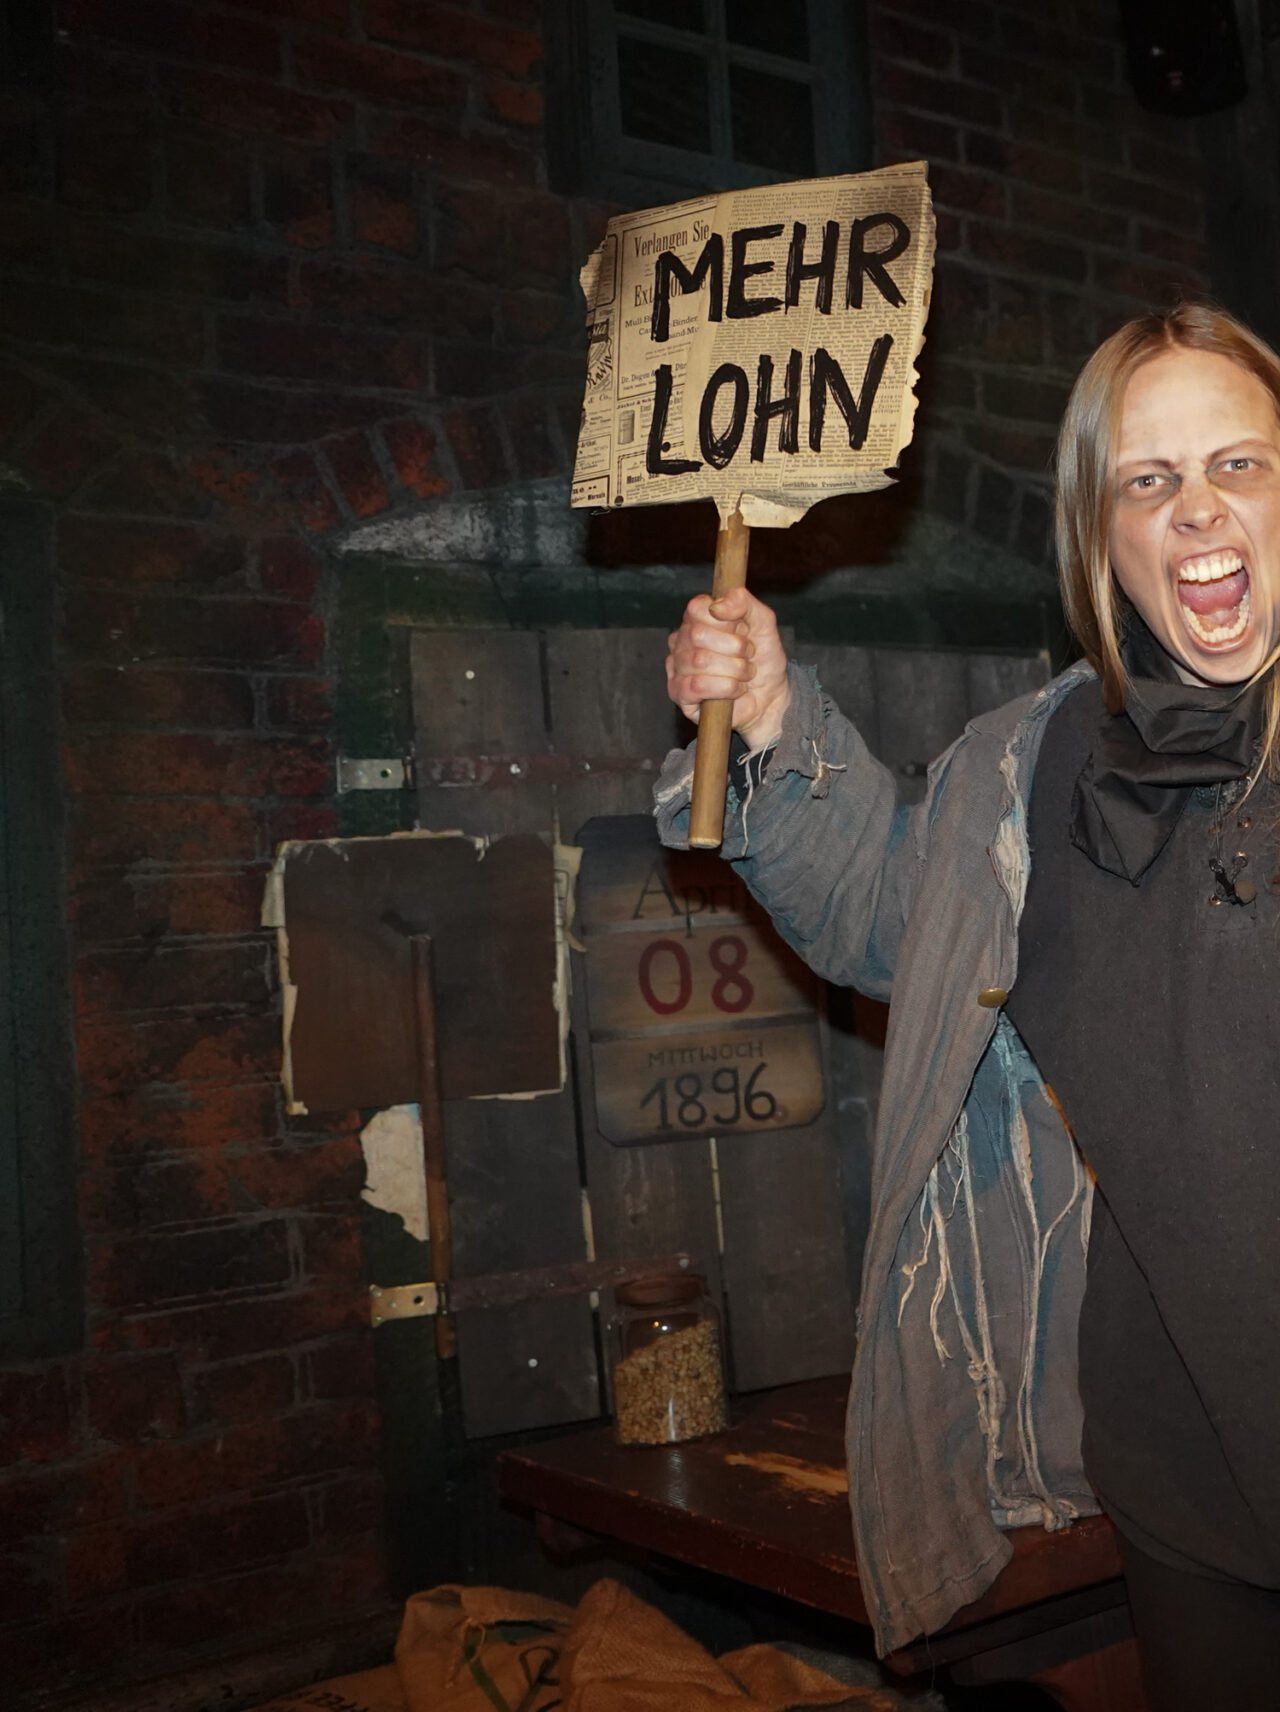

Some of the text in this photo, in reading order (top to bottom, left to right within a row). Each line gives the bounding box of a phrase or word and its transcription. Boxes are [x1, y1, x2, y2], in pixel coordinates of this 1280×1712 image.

[634, 220, 710, 257] Verlangen Sie
[651, 212, 911, 342] MEHR
[647, 334, 894, 475] LOHN
[638, 935, 754, 1015] 08
[648, 1041, 765, 1067] MITTWOCH
[640, 1062, 776, 1130] 1896
